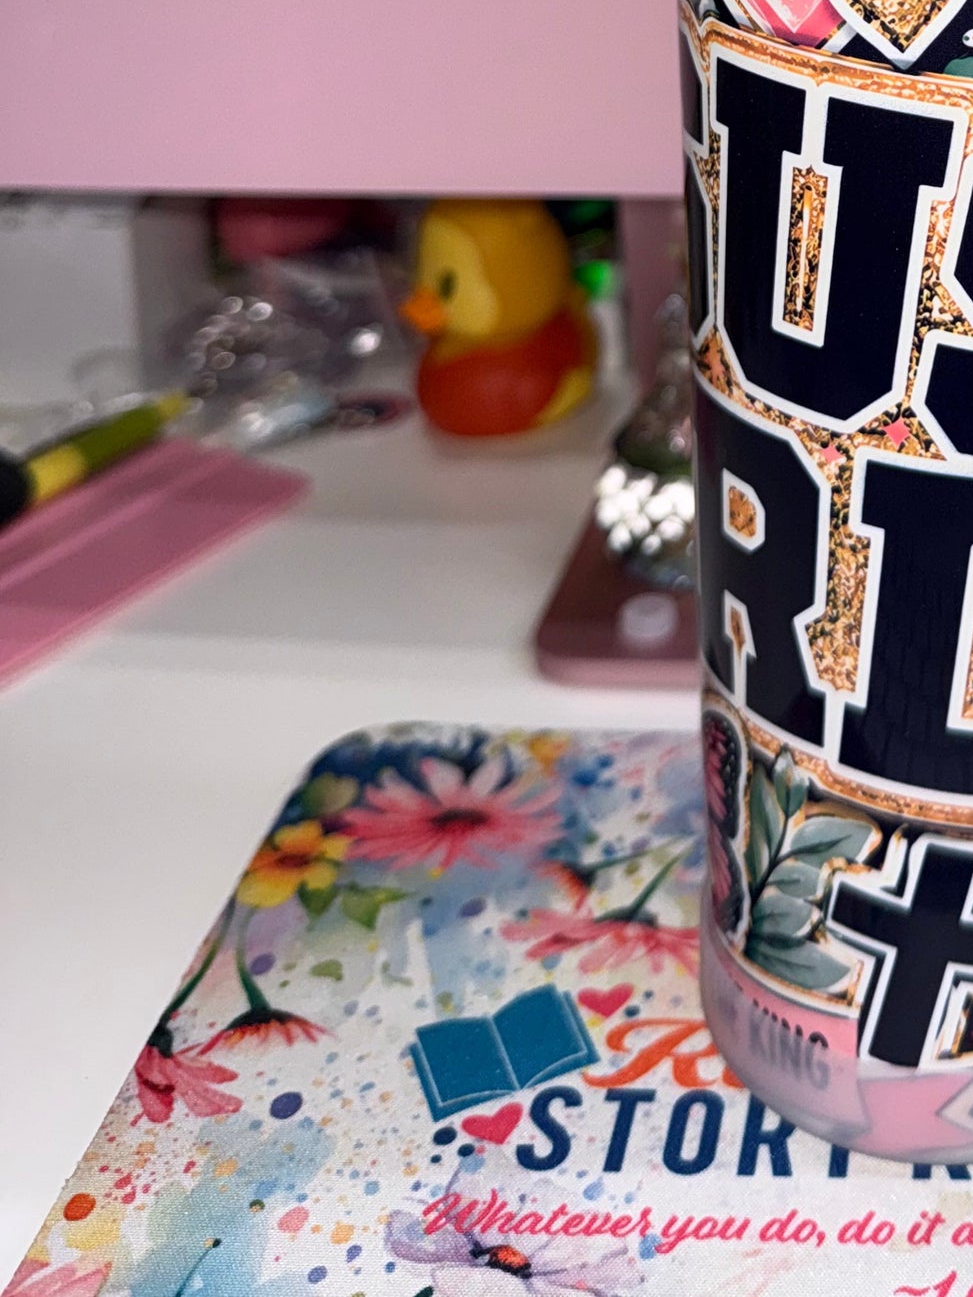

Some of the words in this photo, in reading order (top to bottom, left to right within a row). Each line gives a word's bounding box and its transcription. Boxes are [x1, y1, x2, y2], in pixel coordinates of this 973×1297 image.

[422, 1191, 652, 1238] Whatever
[655, 1213, 746, 1254] you
[759, 1210, 826, 1247] do,
[837, 1210, 897, 1245] do
[906, 1211, 945, 1246] it
